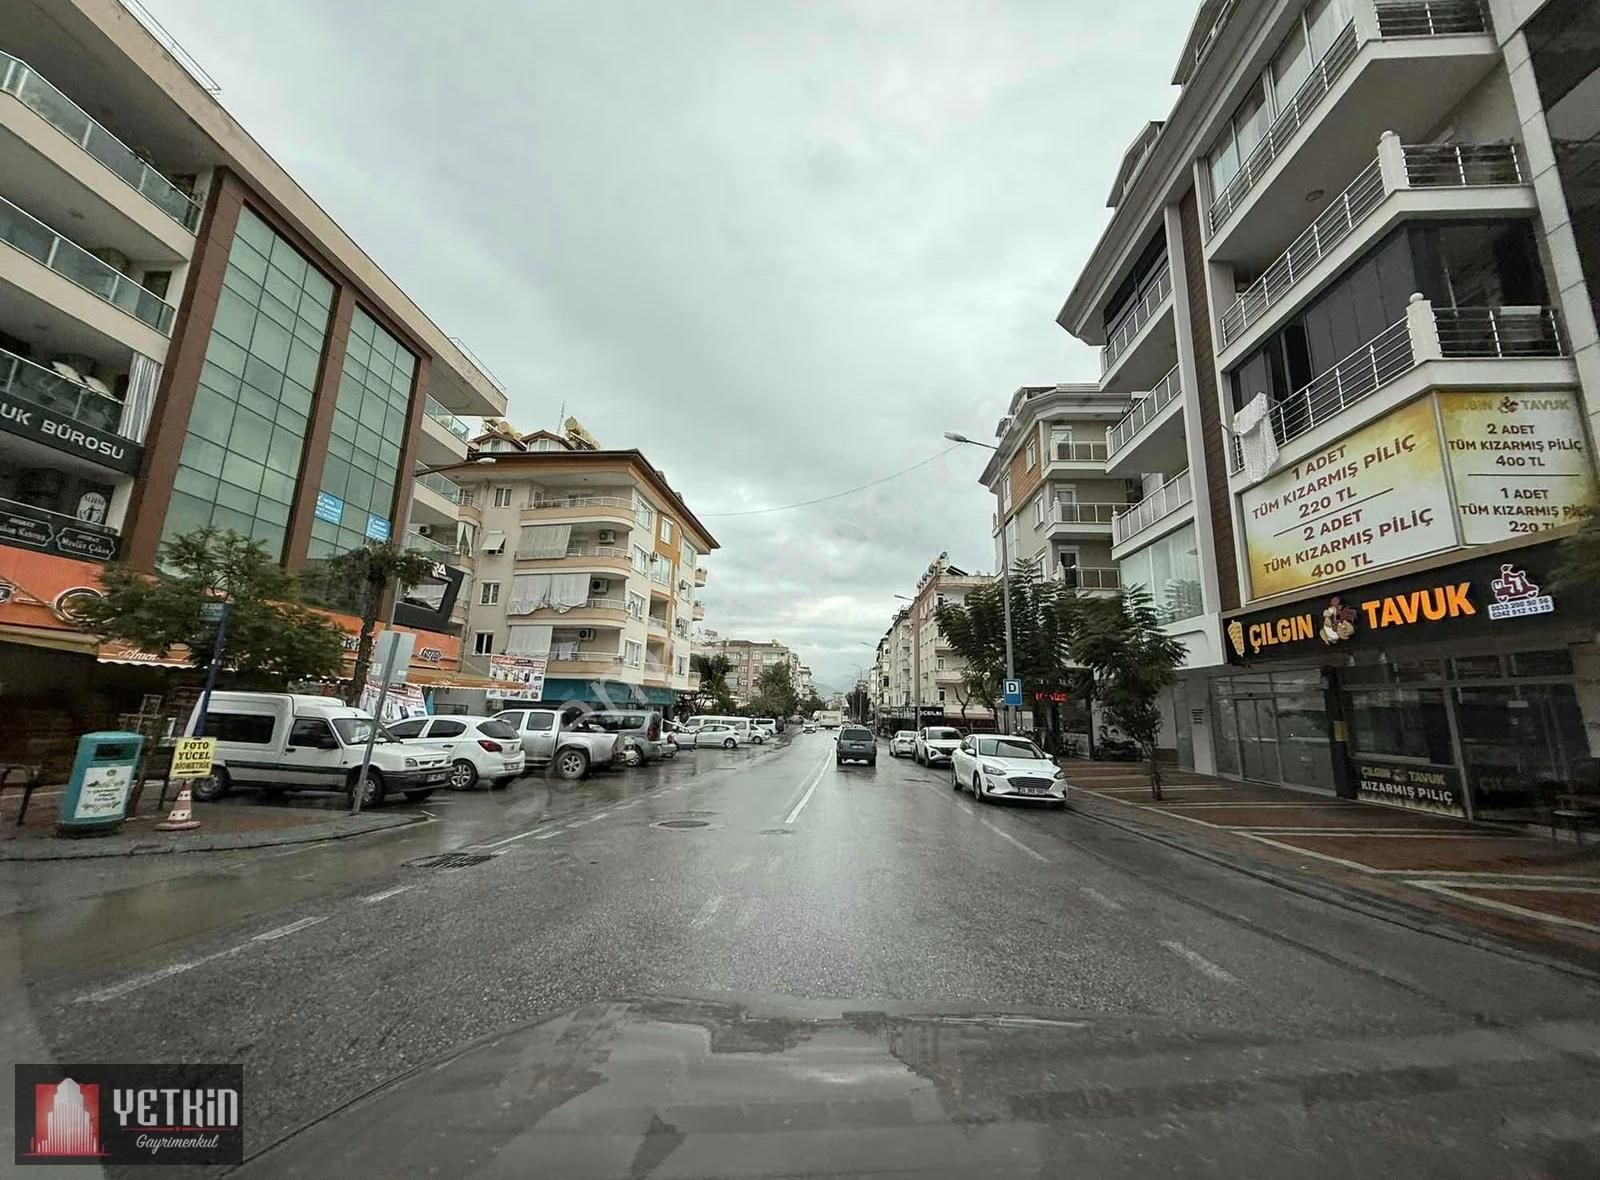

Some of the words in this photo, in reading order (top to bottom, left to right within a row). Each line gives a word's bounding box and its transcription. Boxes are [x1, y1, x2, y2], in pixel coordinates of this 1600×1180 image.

[1520, 399, 1570, 411] TAVUK
[1487, 423, 1497, 435] 2
[1502, 425, 1535, 435] ADET
[41, 419, 124, 459] BÜROSU
[1448, 438, 1477, 451] TÜM
[1481, 440, 1545, 452] KIZARMIŞ
[1548, 438, 1582, 452] PİLİÇ
[1291, 468, 1301, 481] 1
[1306, 445, 1347, 475] ADET
[1496, 455, 1525, 467] 400
[1528, 457, 1545, 467] TL
[1252, 499, 1279, 520] TÜM
[1283, 461, 1358, 506] KIZARMIŞ
[1364, 434, 1417, 469] PİLİÇ
[1500, 488, 1509, 499] 1
[1514, 489, 1549, 499] ADET
[1299, 496, 1331, 519] 220
[1336, 486, 1357, 503] TL
[1460, 503, 1489, 515] TÜM
[1493, 505, 1558, 518] KIZARMIŞ
[1303, 526, 1315, 541] 2
[1320, 509, 1363, 536] ADET
[1509, 520, 1538, 532] 220
[1264, 556, 1291, 573] TÜM
[1295, 528, 1373, 564] KIZARMIŞ
[1379, 508, 1433, 537] PİLİÇ
[1311, 559, 1346, 578] 400
[1351, 552, 1373, 568] TL
[1249, 614, 1314, 654] ÇILGIN
[1362, 582, 1475, 629] TAVUK
[1008, 682, 1016, 693] D
[184, 742, 209, 750] FOTO
[178, 750, 210, 760] YÜCEL
[1408, 771, 1445, 785] TAVUK
[1360, 780, 1415, 799] KIZARMIŞ
[1418, 787, 1453, 805] PİLİÇ
